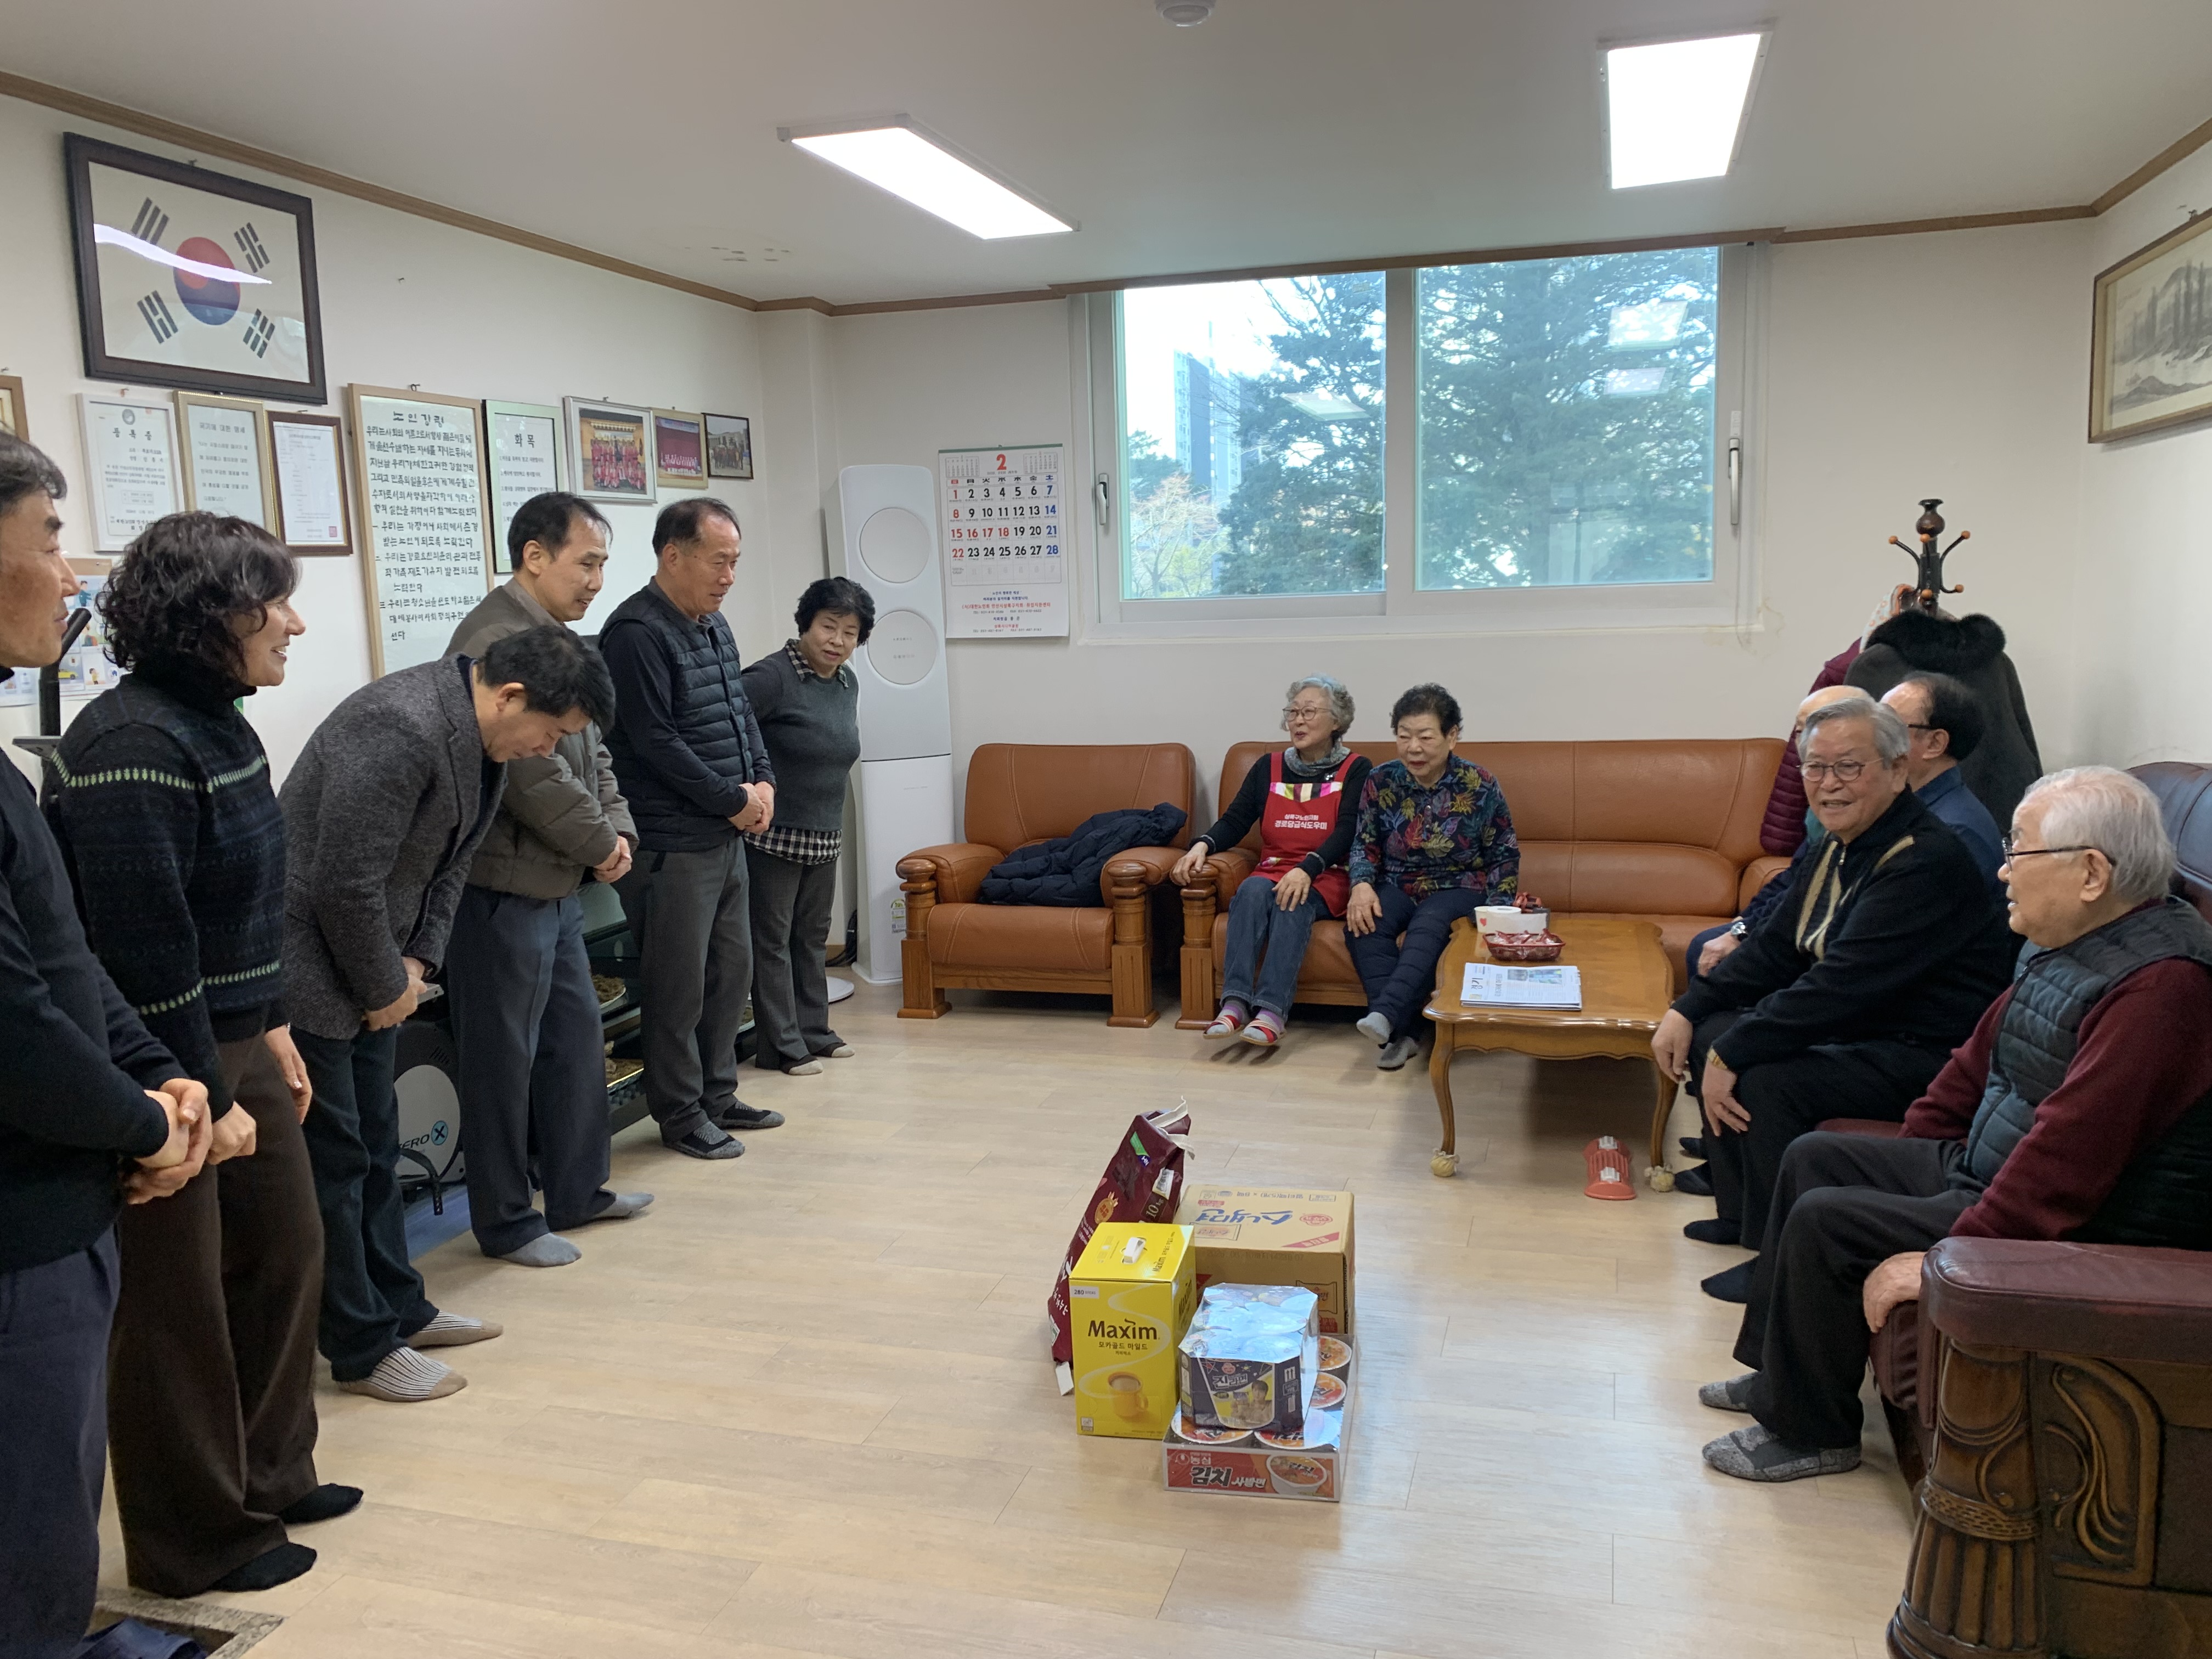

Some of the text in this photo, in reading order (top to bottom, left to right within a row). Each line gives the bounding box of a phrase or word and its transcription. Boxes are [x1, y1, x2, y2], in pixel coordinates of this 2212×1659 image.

[996, 454, 1007, 471] 2
[371, 473, 390, 483] 그리고
[953, 485, 1053, 499] 1 2 3 4 5 6 7
[953, 505, 1056, 518] 8 9 10 11 12 13 14
[381, 521, 404, 532] 우리는
[951, 525, 1057, 538] 15 16 17 18 19 20 21
[952, 545, 1058, 558] 22 23 24 25 26 27 28
[394, 583, 422, 593] 노력한다
[387, 599, 410, 609] 우리는
[1274, 820, 1328, 830] 경로당급식도우미
[1471, 978, 1483, 990] 경기
[1146, 1203, 1160, 1219] 10
[1195, 1208, 1293, 1225] 스낵면
[1088, 1318, 1159, 1340] Maxim
[1098, 1341, 1125, 1350] 모카골드
[1190, 1455, 1211, 1465] 농심
[1190, 1466, 1233, 1488] 김치
